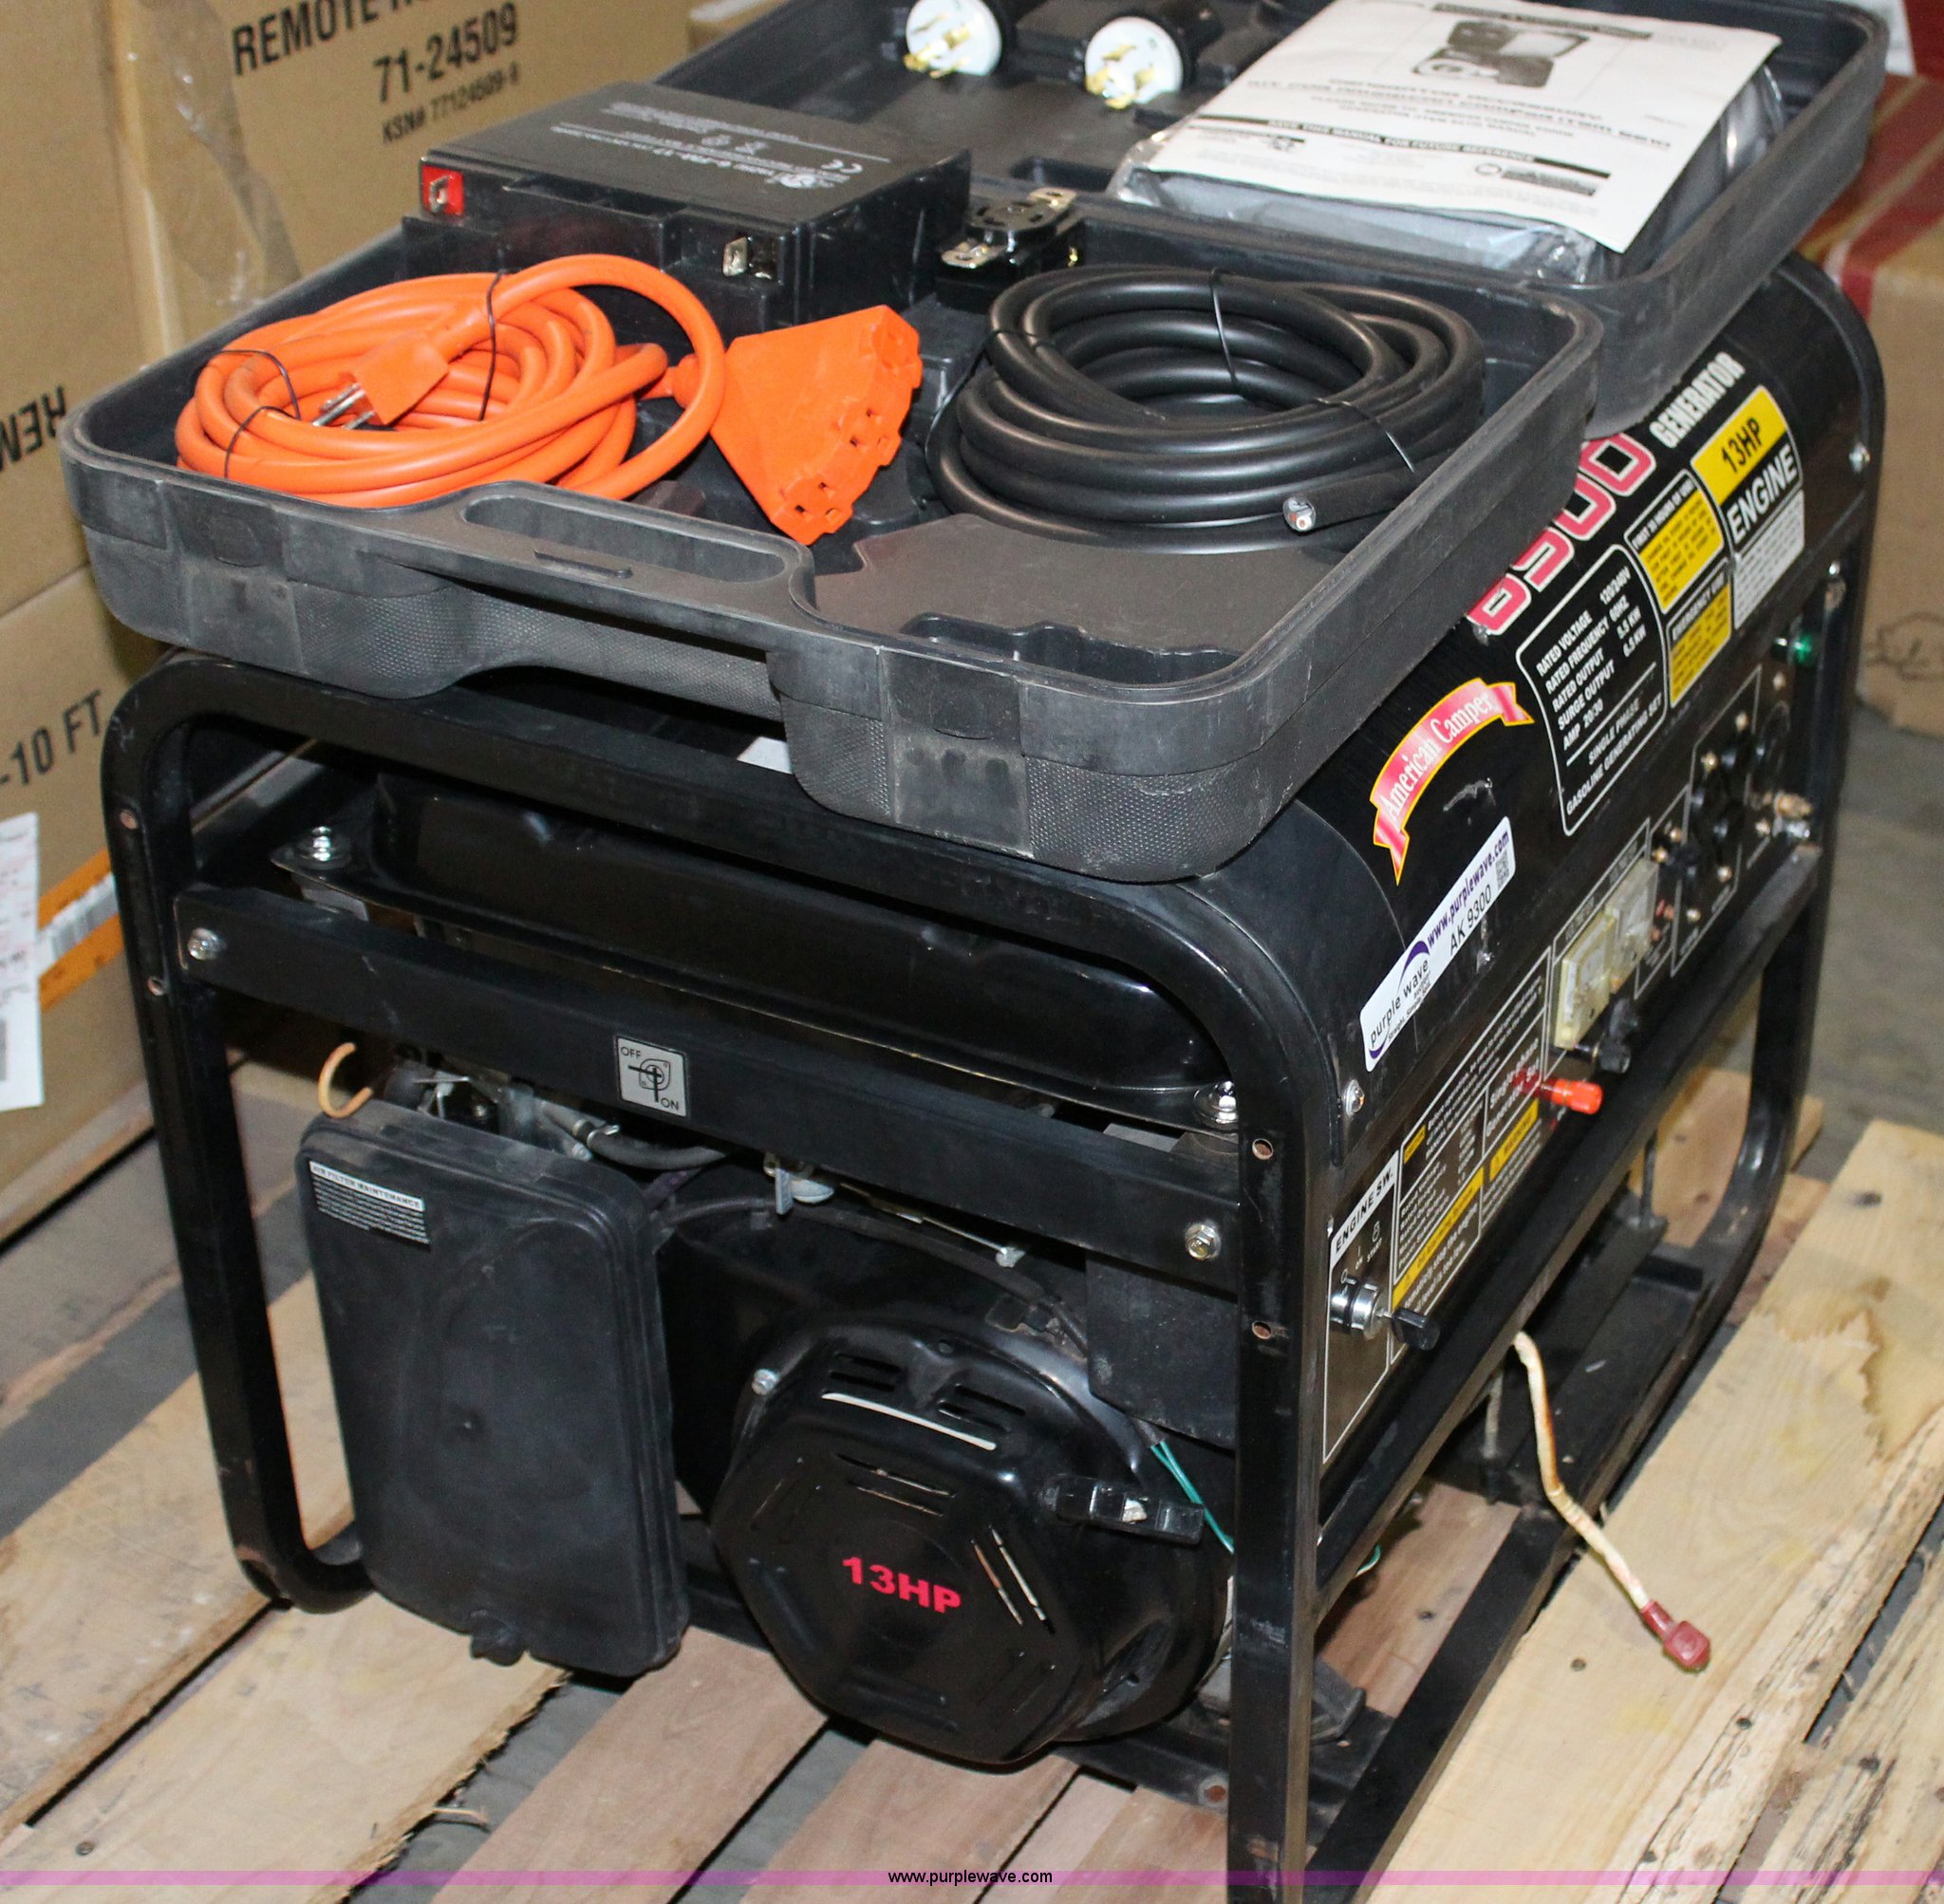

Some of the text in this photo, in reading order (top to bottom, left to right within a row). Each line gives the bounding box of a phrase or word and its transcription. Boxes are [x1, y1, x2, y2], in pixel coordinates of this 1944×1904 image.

[373, 2, 518, 103] 71-24509
[382, 107, 425, 143] KSN#
[1649, 351, 1746, 449] GENERATOR
[1720, 417, 1764, 474] 13HP
[1726, 443, 1798, 545] ENGINE
[1536, 644, 1562, 677] RATED
[1559, 609, 1593, 647] VOLTAGE
[1544, 662, 1571, 695] RATED
[1568, 615, 1611, 667] FREQUENCY
[1551, 679, 1578, 712] RATED
[1575, 647, 1605, 686] OUTPUT
[1558, 693, 1586, 731] SURGE
[1583, 659, 1616, 702] OUTPUT
[65, 689, 103, 755] FT
[1379, 692, 1492, 824] American Camper
[1564, 722, 1581, 751] AMP
[1588, 727, 1616, 766] SINGLE
[1566, 763, 1605, 815] GASOLINE
[1603, 711, 1649, 771] GENERATING
[1427, 831, 1510, 948] www.purplewave.com
[1449, 884, 1493, 958] AK 9300
[1370, 959, 1429, 1049] purple wave
[620, 1046, 642, 1060] OFF
[661, 1097, 680, 1111] ON
[1335, 1169, 1395, 1257] ENGINE SW.
[841, 1556, 963, 1615] 13HP
